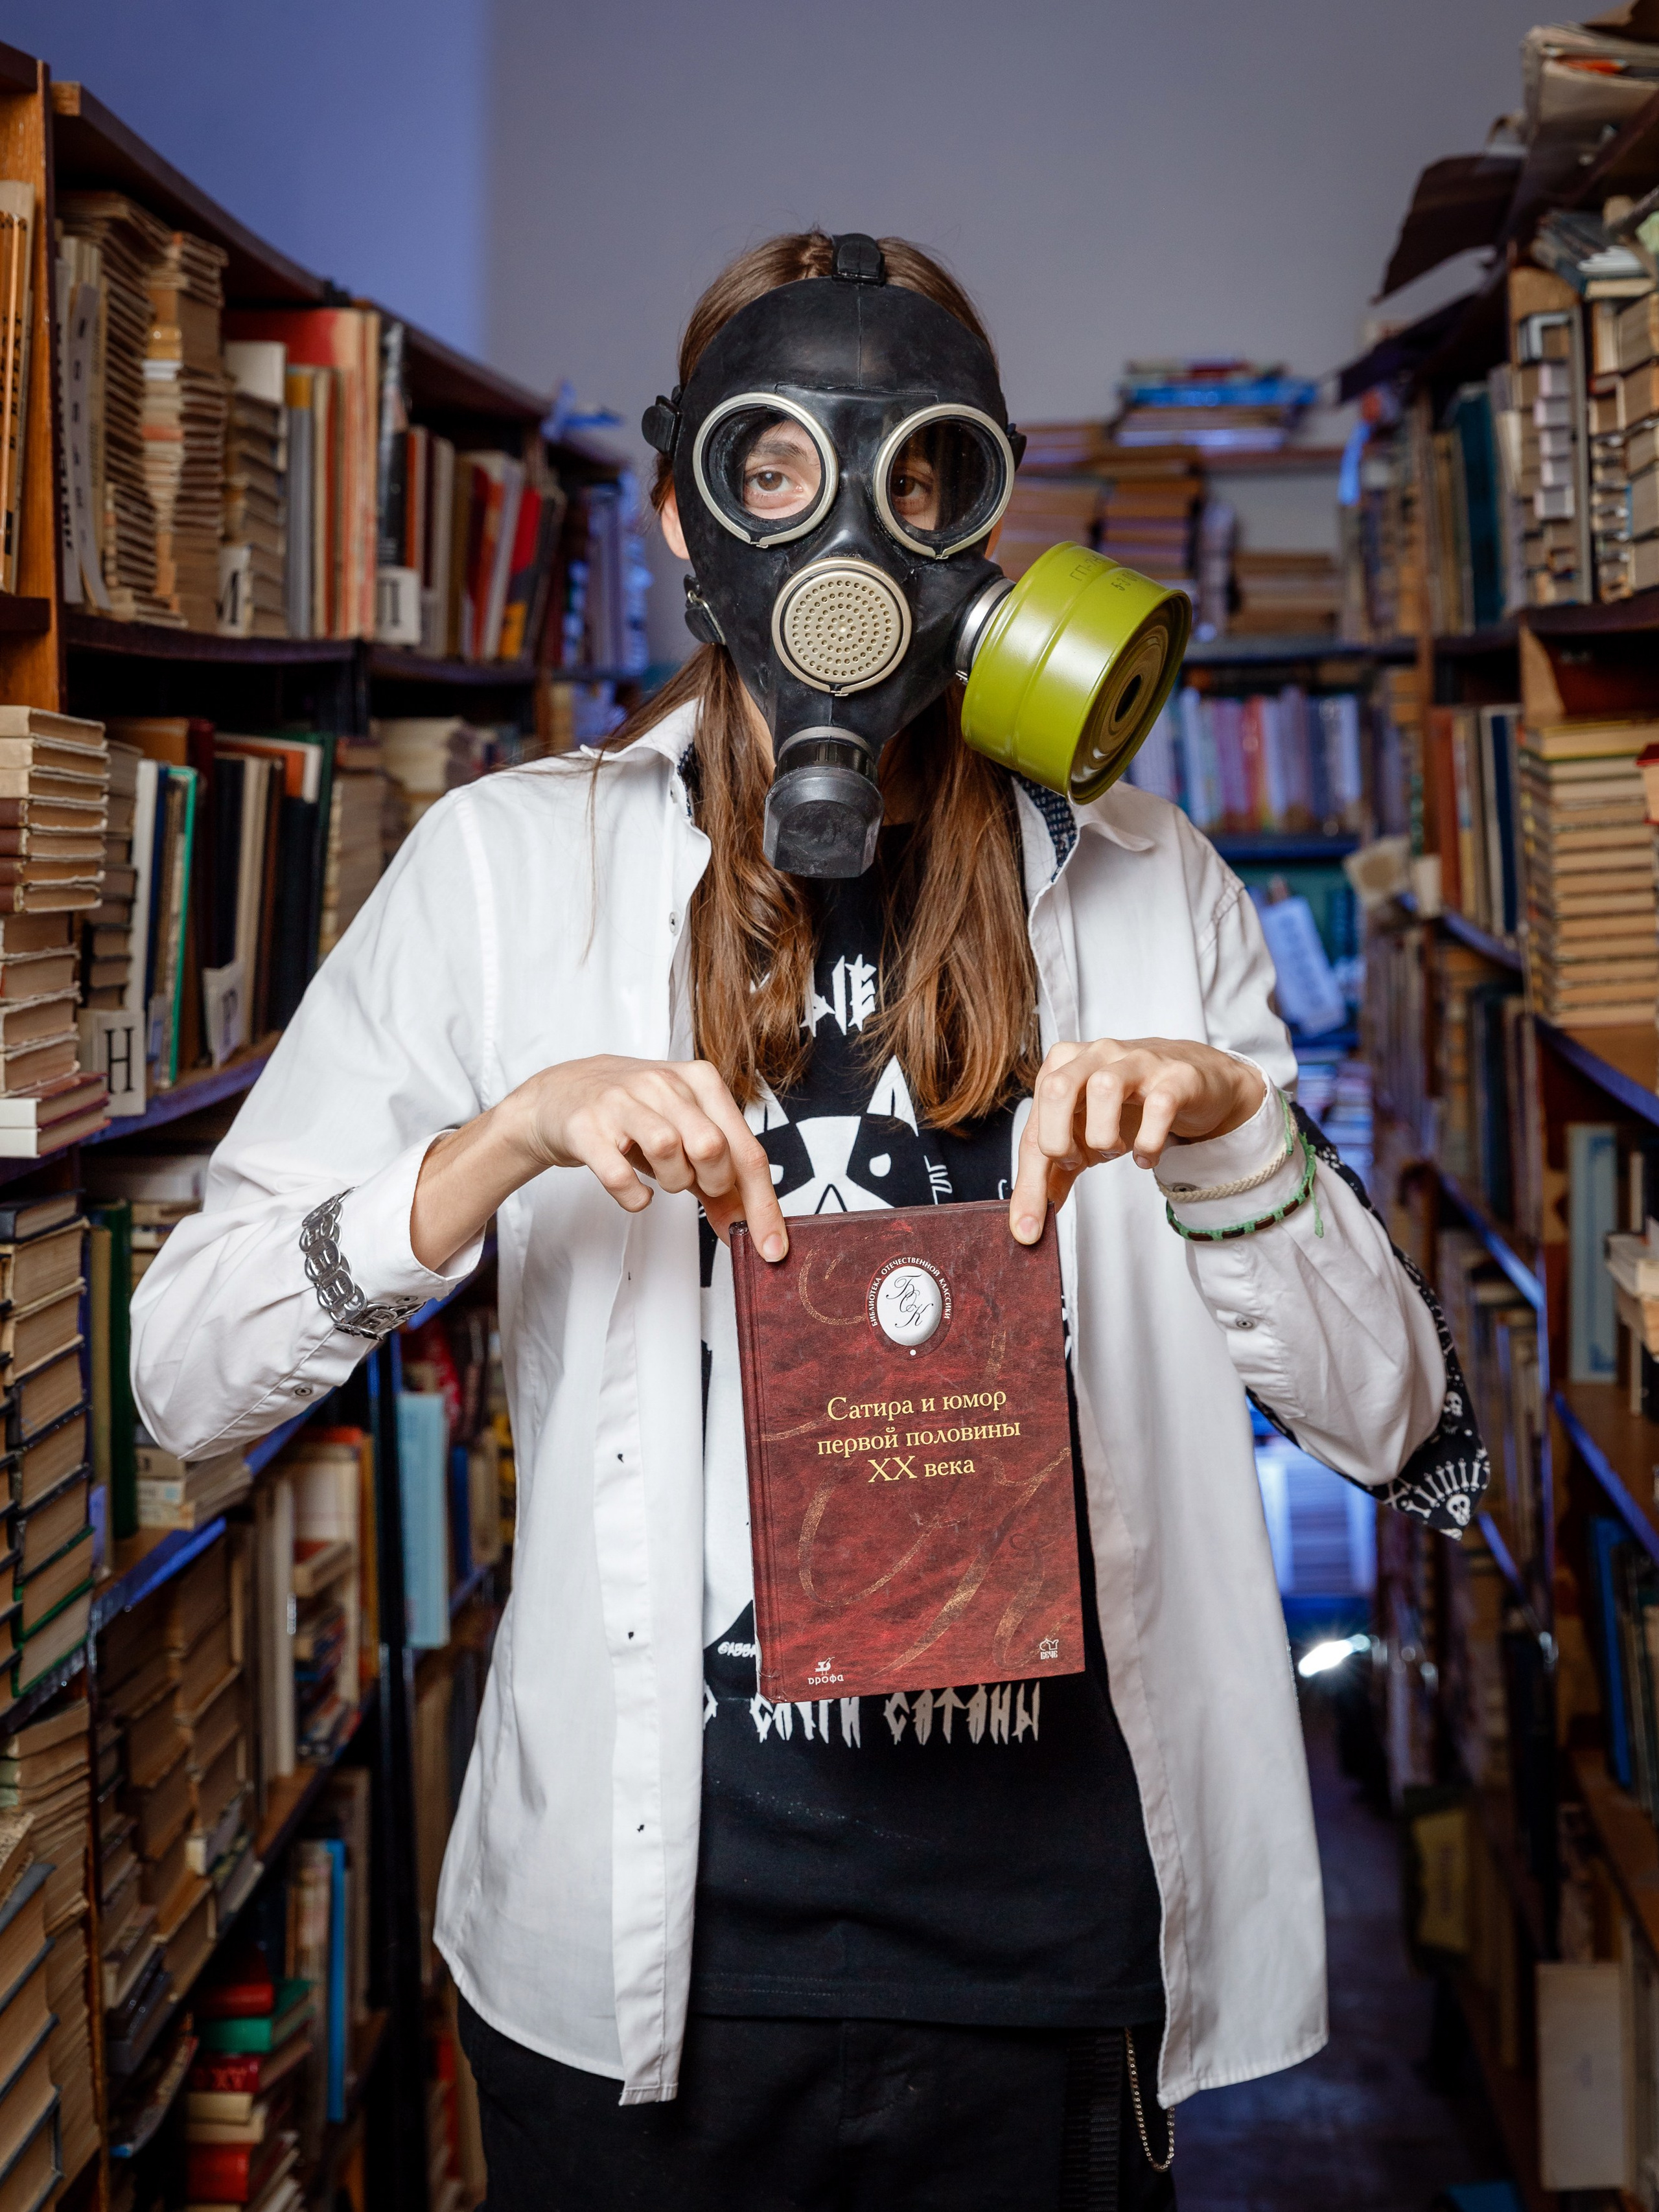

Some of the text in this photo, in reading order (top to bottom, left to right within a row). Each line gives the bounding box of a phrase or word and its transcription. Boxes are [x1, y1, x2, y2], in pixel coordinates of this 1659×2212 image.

[105, 1026, 134, 1095] Н
[868, 1257, 951, 1327] БИБЛИОТЕКА ОТЕЧЕСТВЕННОЙ КЛАССИКИ
[827, 1390, 1007, 1422] Сатира и юмор
[817, 1421, 1021, 1458] первой половины
[868, 1455, 976, 1483] XX века
[883, 1681, 1041, 1745] САТАНЫ
